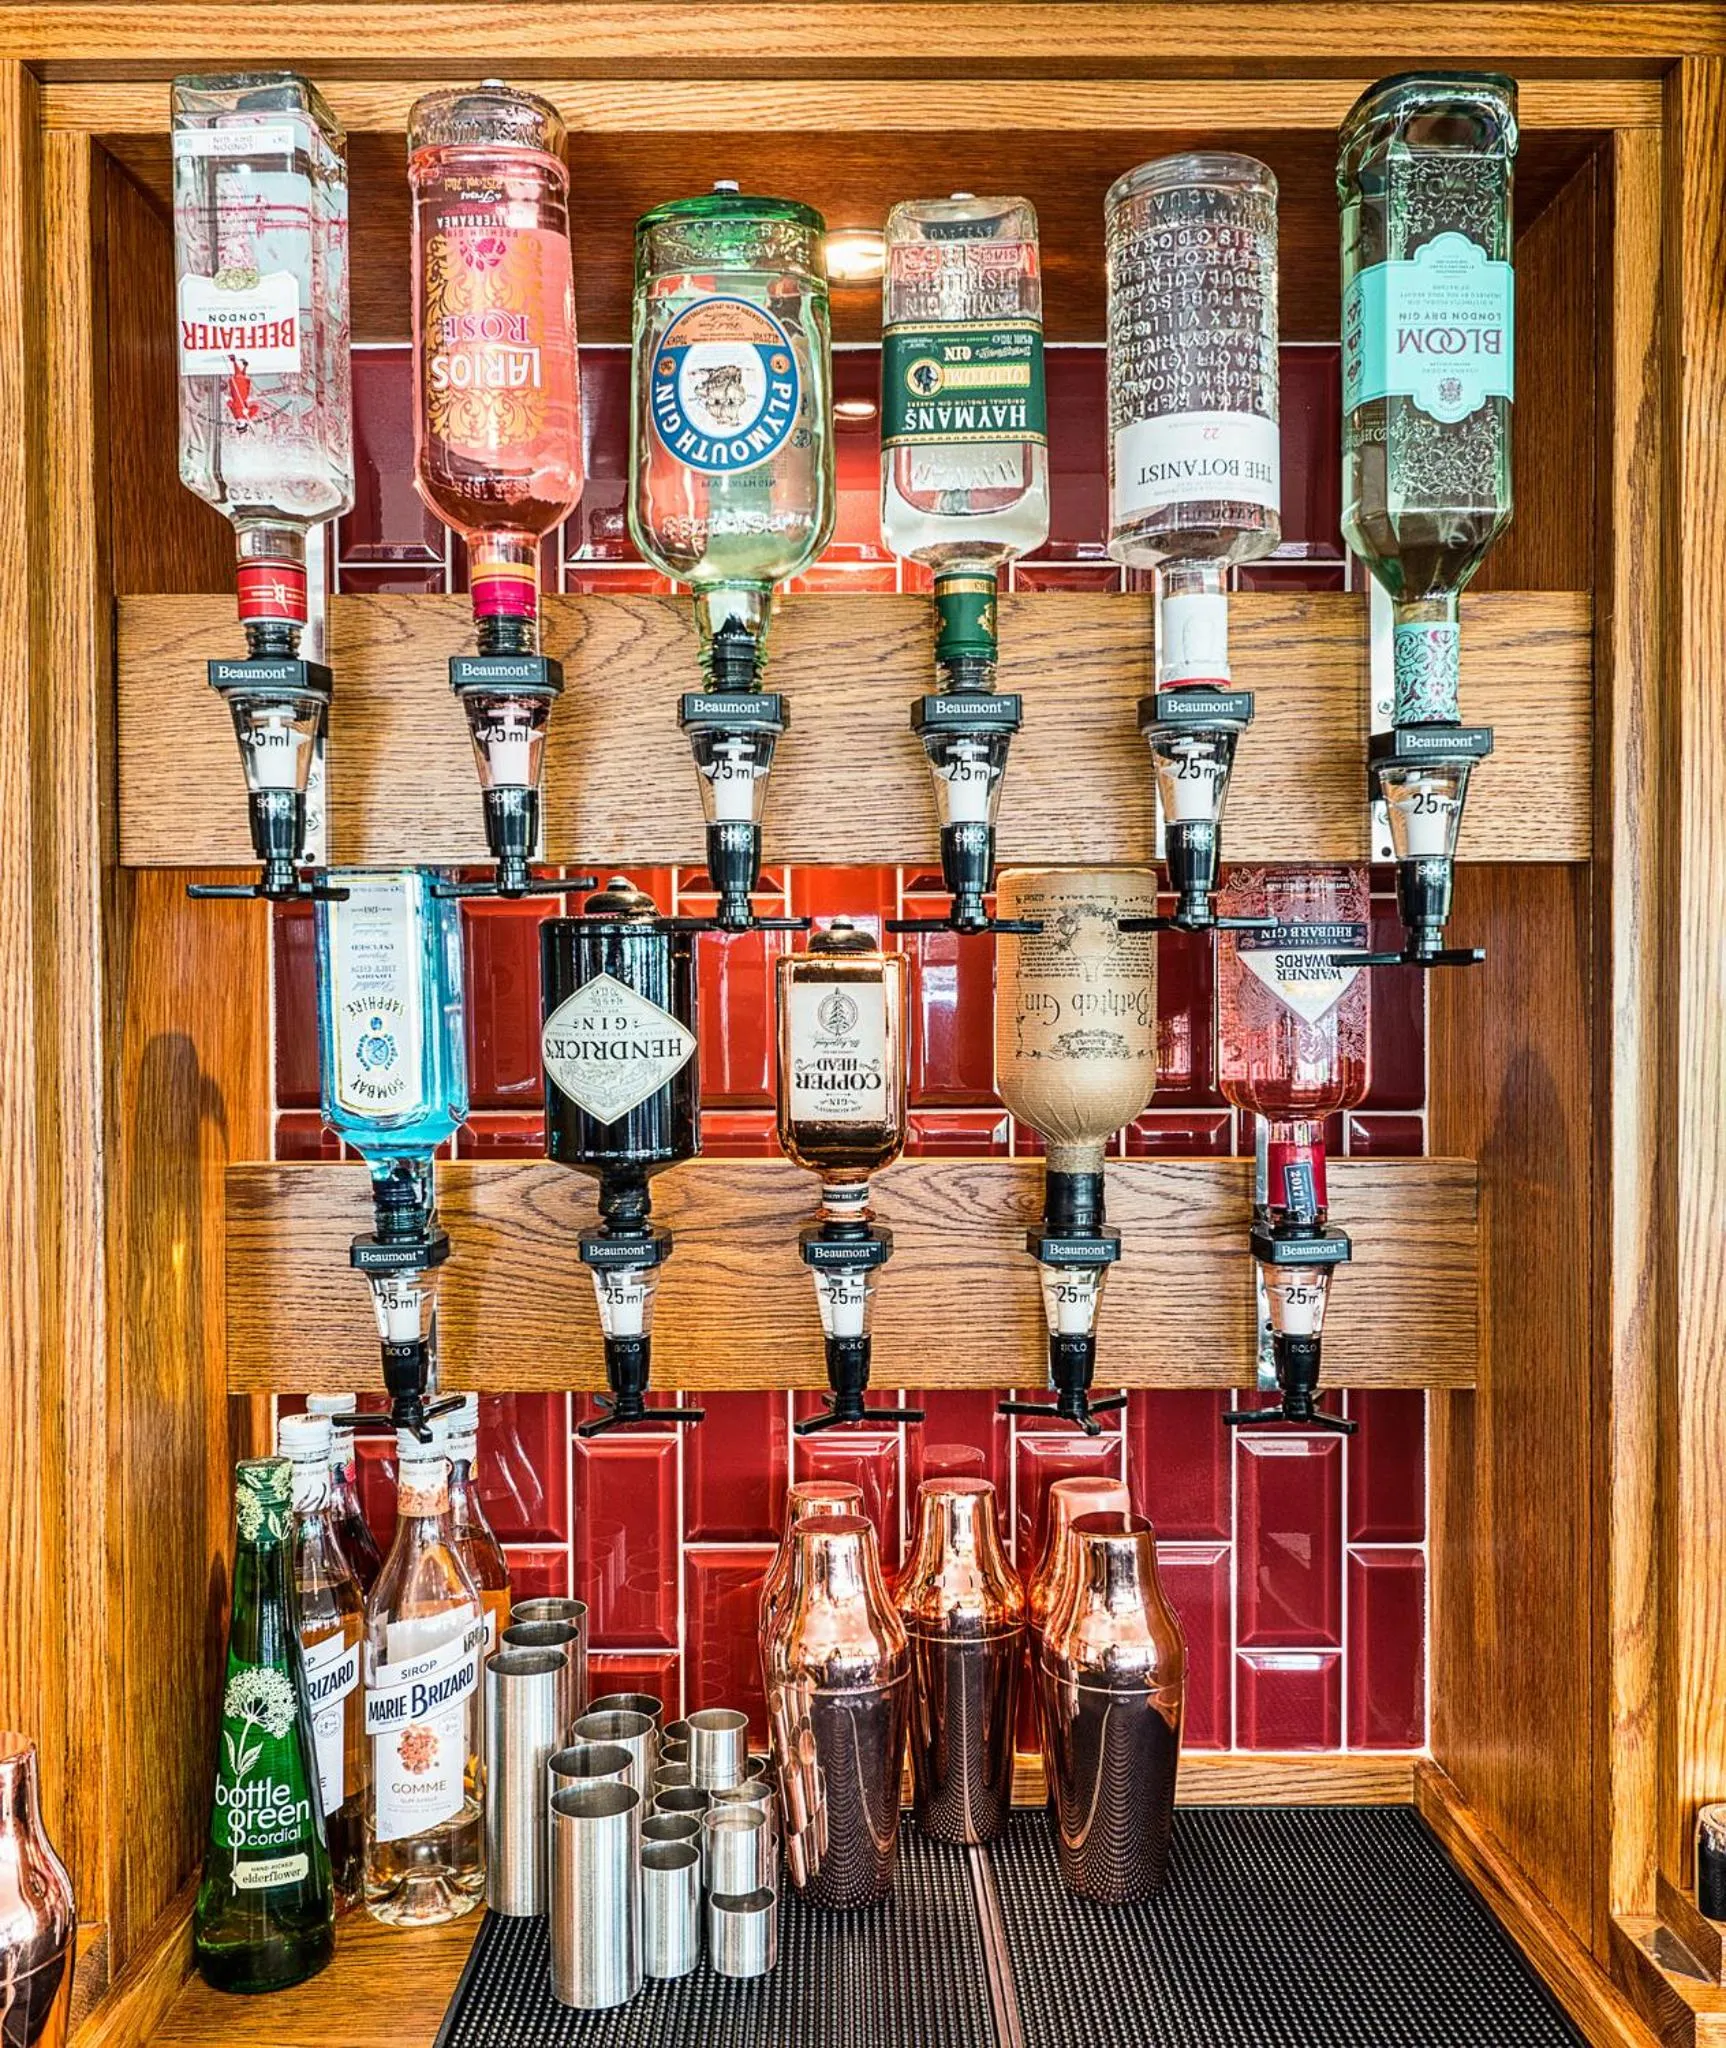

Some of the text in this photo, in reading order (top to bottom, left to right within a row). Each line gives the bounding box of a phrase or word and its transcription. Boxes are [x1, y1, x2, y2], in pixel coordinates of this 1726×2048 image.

[446, 229, 519, 238] PREMIUM GIN
[207, 313, 266, 322] LONDON
[1398, 311, 1502, 321] LONDON DRY GIN
[181, 317, 296, 350] BEEFEATER
[440, 308, 531, 348] ROSÉ
[1396, 328, 1503, 355] BLOOM
[944, 346, 972, 361] GIN
[431, 344, 542, 389] LARIOS
[937, 399, 952, 407] GIN
[954, 398, 987, 406] ENGLISH
[655, 380, 793, 465] PLYMOUTH GIN
[1202, 427, 1220, 440] 22
[1137, 459, 1273, 486] THE BOTANIST
[256, 797, 290, 808] SOLO
[488, 791, 523, 803] SOLO
[720, 831, 752, 843] SOLO
[954, 832, 986, 843] SOLO
[1182, 829, 1213, 842] SOLO
[1417, 864, 1449, 876] SOLO
[1260, 926, 1353, 939] RHUBARB GIN
[1279, 938, 1338, 946] VICTORIA'S
[1275, 953, 1334, 968] DWARDS
[1275, 967, 1343, 983] WARNER
[345, 996, 406, 1020] SAPPHIRE
[1023, 987, 1149, 1026] Bathtub Gin
[582, 1016, 628, 1030] GIN
[544, 1038, 683, 1060] HENDRICK'S
[816, 1058, 857, 1072] HEAD
[349, 1077, 406, 1099] BOMBAY
[795, 1072, 882, 1091] COPPER
[829, 1098, 848, 1106] GIN
[1289, 1170, 1306, 1199] 2017
[384, 1347, 411, 1357] SOLO
[614, 1343, 641, 1353] SOLO
[839, 1341, 865, 1352] SOLO
[1060, 1342, 1088, 1352] SOLO
[1290, 1344, 1317, 1354] SOLO
[400, 1659, 438, 1680] SIROP
[307, 1659, 354, 1702] RIZARD
[368, 1662, 475, 1722] MARIE BRIZARD
[214, 1772, 291, 1809] bottle
[391, 1780, 448, 1795] GOMME
[226, 1798, 311, 1846] green
[246, 1827, 301, 1846] cordial
[241, 1867, 302, 1884] elderflower
